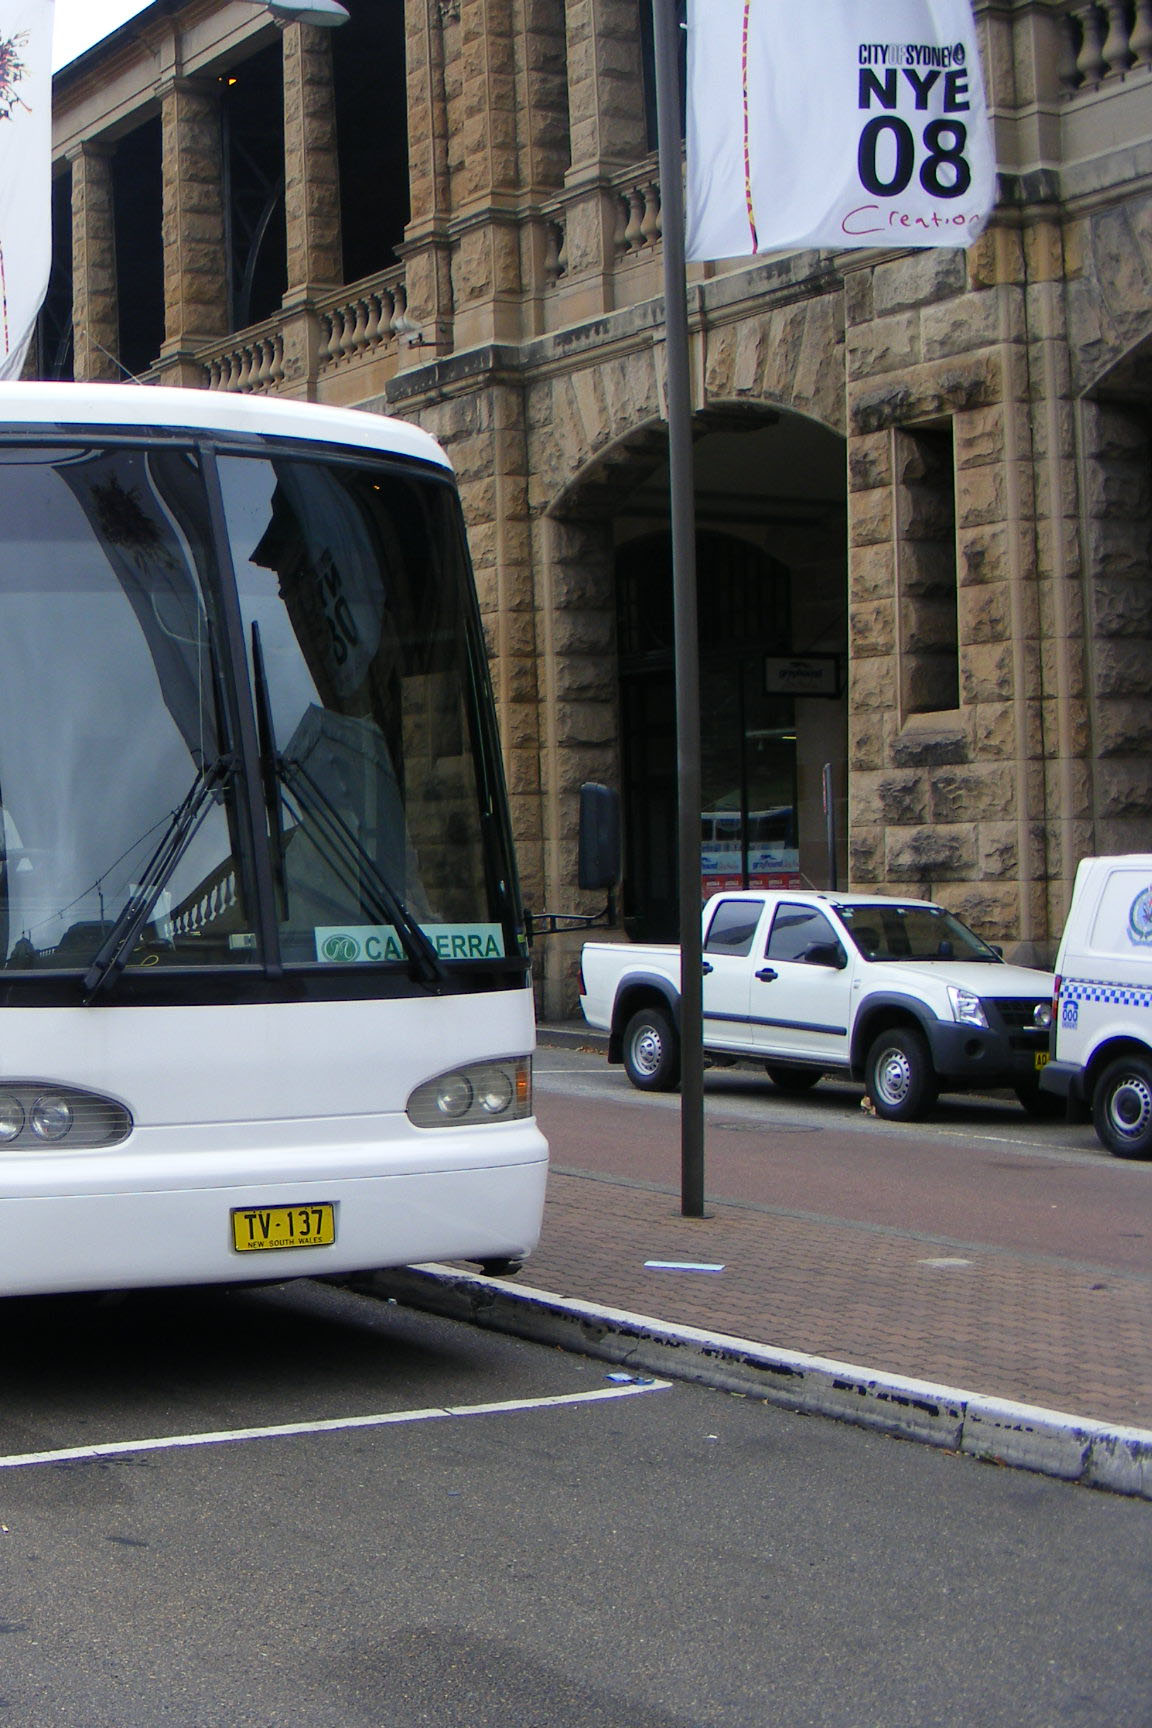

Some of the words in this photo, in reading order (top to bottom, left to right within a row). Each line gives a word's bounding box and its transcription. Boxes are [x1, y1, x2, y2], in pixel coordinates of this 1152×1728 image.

[858, 67, 970, 113] NYE
[858, 115, 971, 199] 08
[841, 205, 981, 235] Creation
[365, 934, 500, 960] CAERRA
[1062, 1009, 1079, 1022] 000
[248, 1241, 264, 1249] NEW
[269, 1239, 295, 1247] SOUTH
